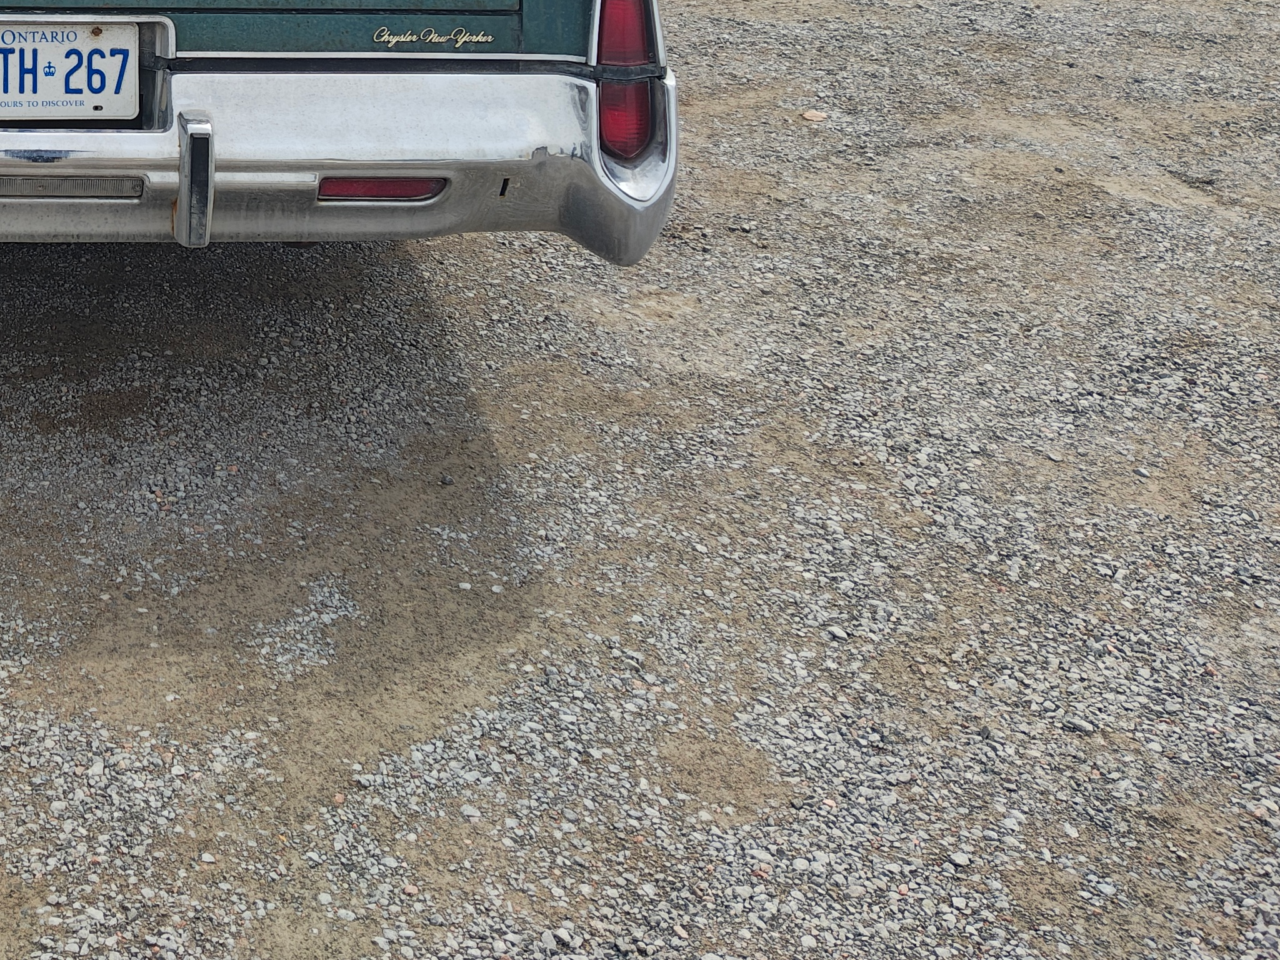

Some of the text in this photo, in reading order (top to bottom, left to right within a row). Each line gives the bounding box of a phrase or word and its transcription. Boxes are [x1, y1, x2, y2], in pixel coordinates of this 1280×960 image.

[1, 29, 78, 45] ONTARIO
[373, 26, 495, 48] Chrysler New Yorker
[64, 48, 130, 95] 267
[26, 100, 39, 108] TO
[41, 99, 85, 108] DISCOVER
